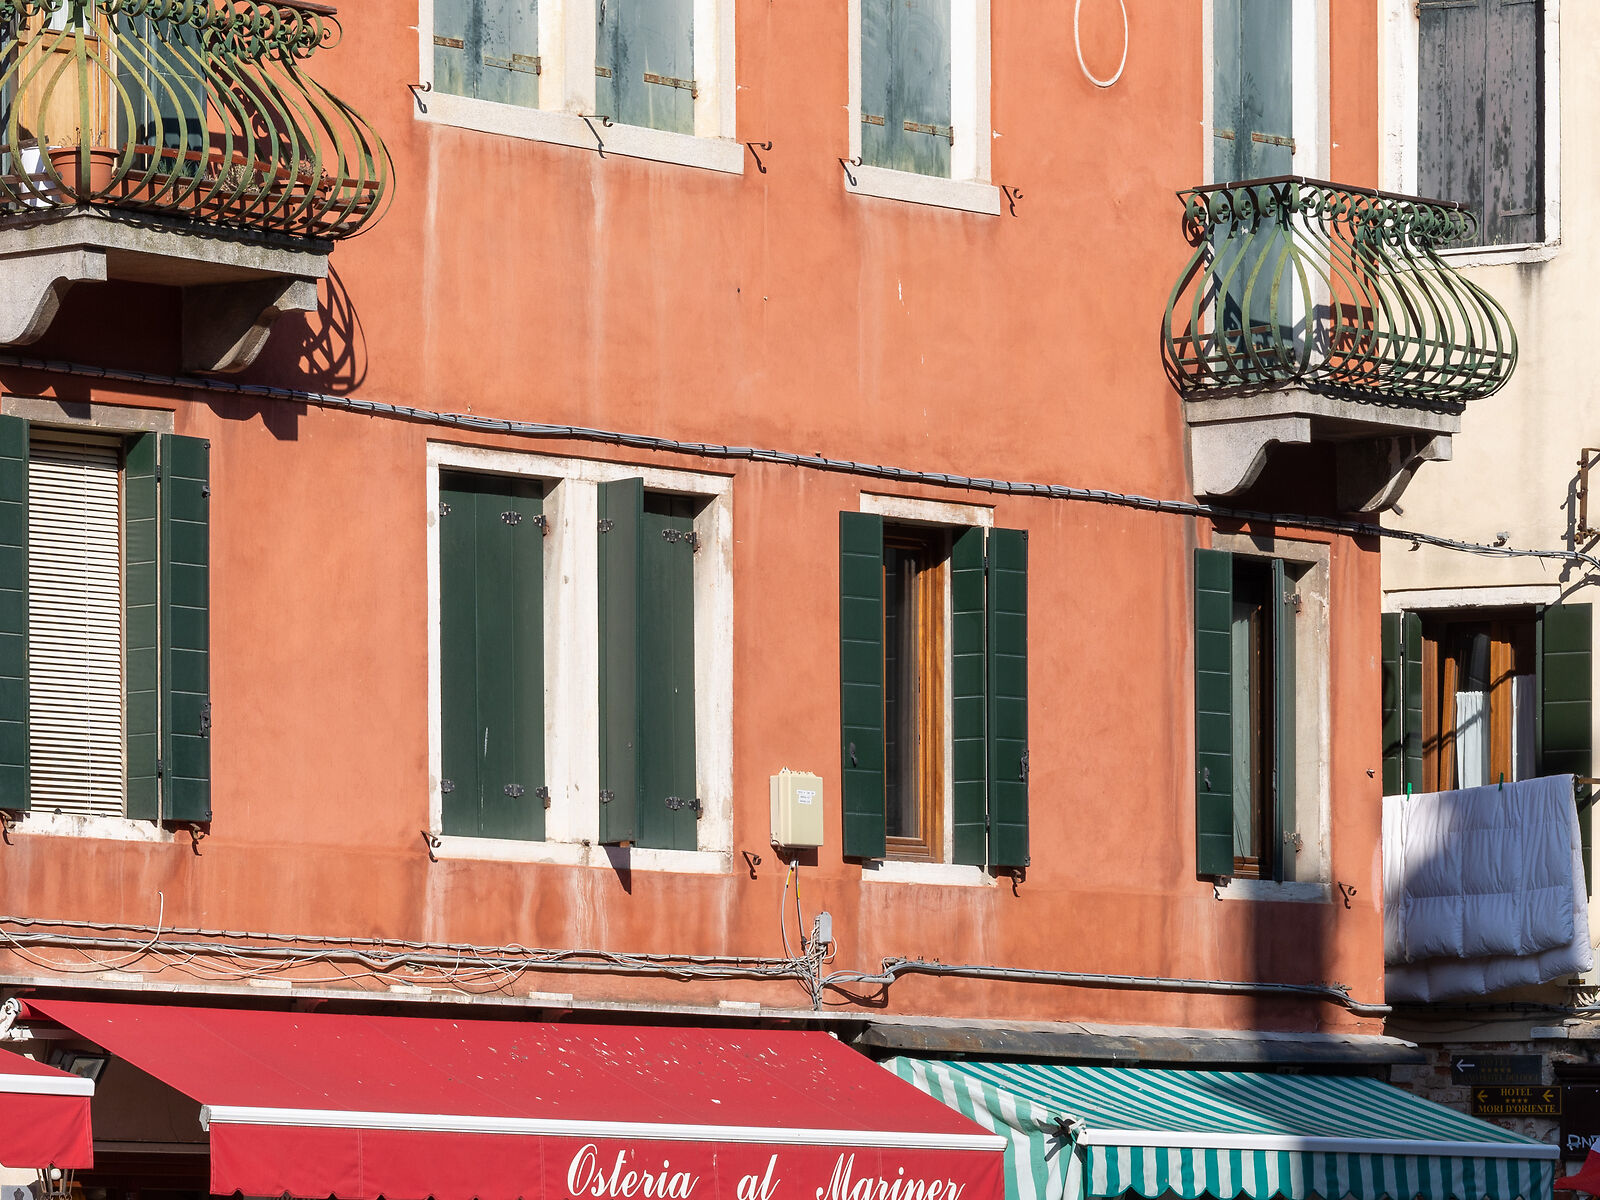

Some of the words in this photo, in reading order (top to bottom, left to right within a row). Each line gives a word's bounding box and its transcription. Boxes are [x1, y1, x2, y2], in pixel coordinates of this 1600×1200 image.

[1500, 1088, 1533, 1096] HOTEL
[1478, 1104, 1503, 1113] MORI
[1505, 1104, 1556, 1113] D'ORIENTE
[567, 1143, 700, 1199] Osteria
